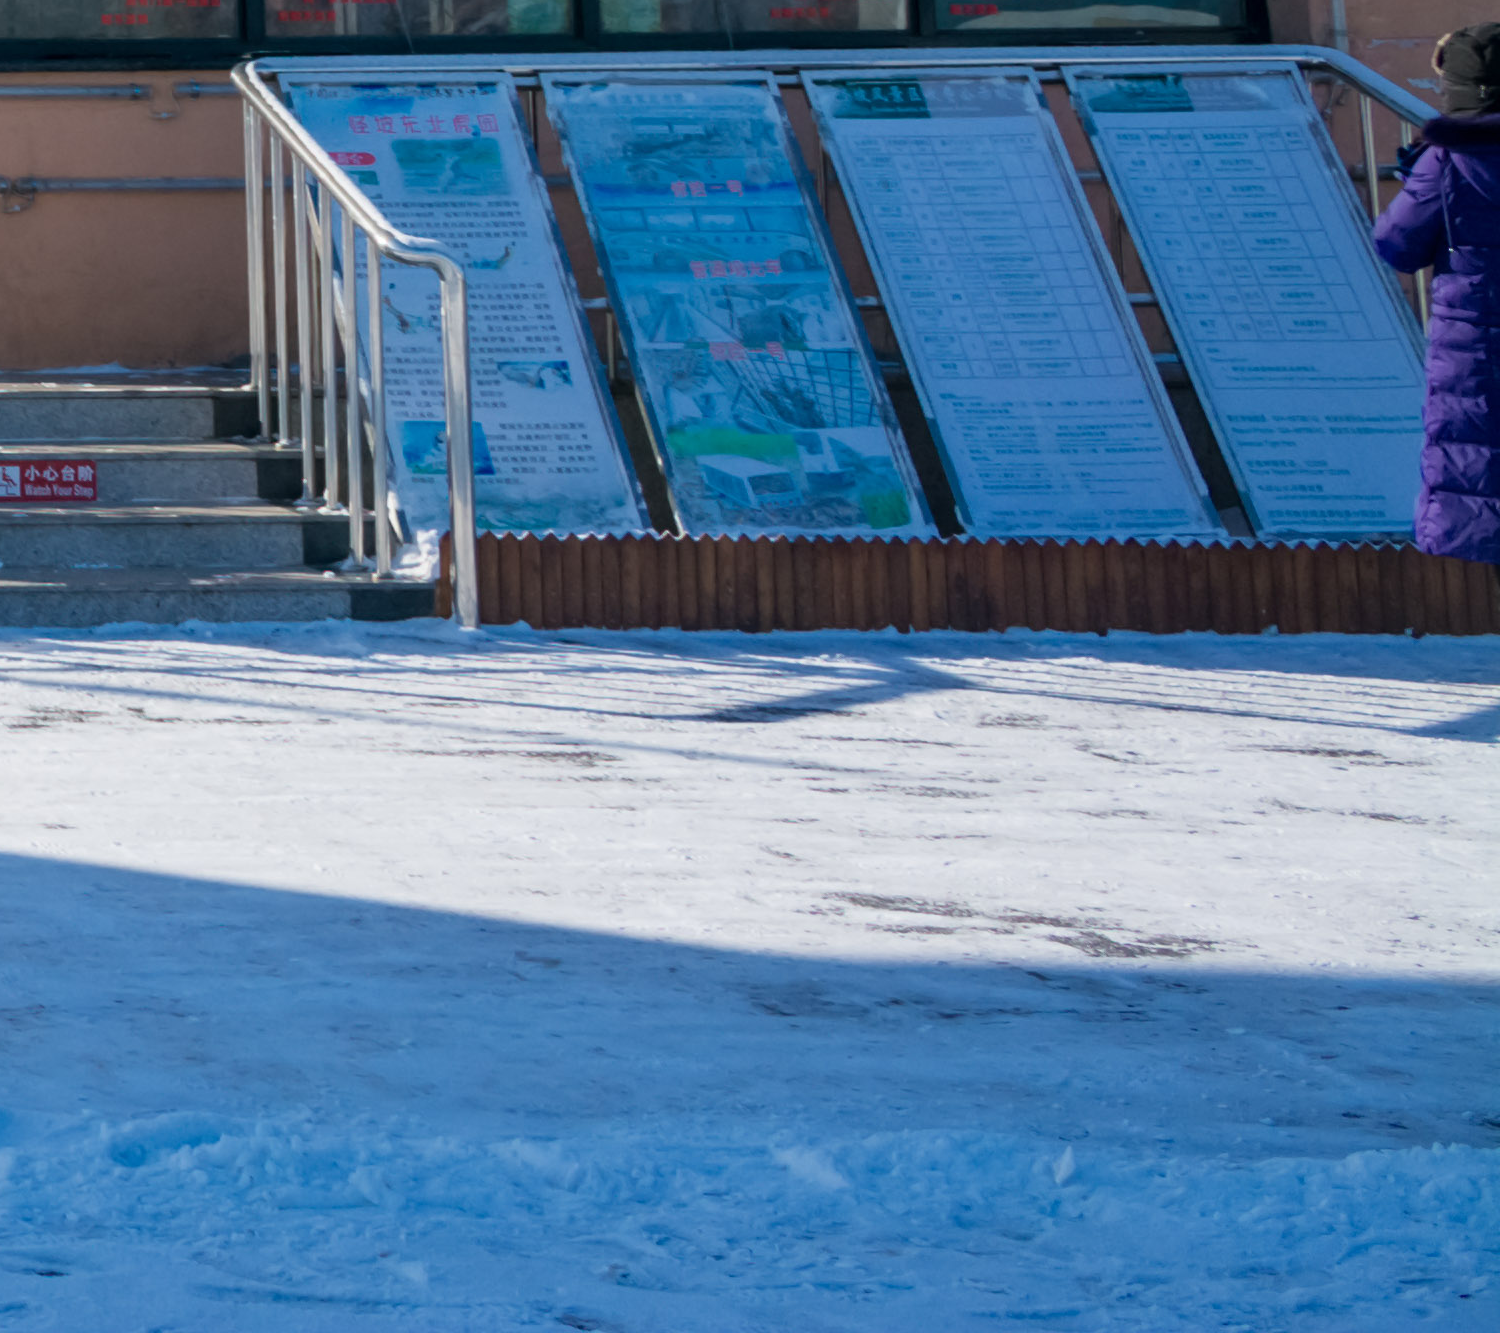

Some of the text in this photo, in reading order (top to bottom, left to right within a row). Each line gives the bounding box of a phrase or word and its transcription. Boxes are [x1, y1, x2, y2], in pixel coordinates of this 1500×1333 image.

[350, 114, 500, 134] 怪坡东北虎园
[24, 465, 94, 482] 小心台阶
[24, 483, 94, 498] Watch Your Step
